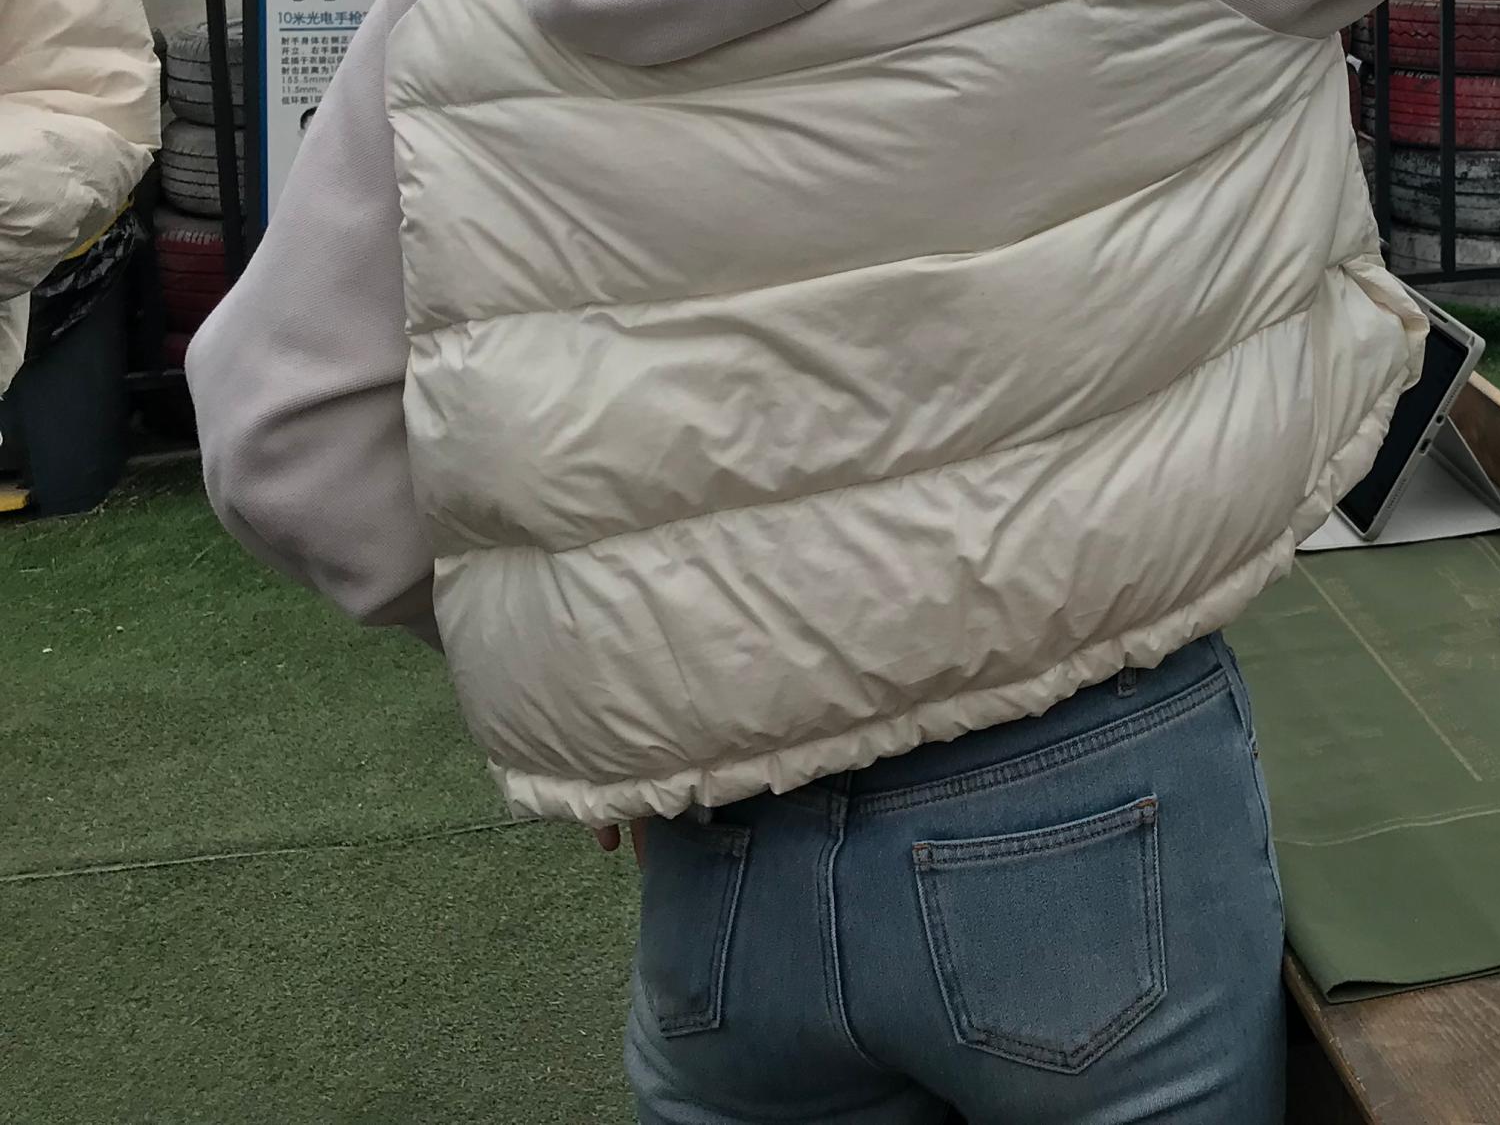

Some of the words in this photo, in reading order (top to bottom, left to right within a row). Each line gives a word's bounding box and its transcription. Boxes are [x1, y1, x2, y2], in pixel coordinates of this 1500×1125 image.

[278, 11, 368, 25] 10米光电手枪
